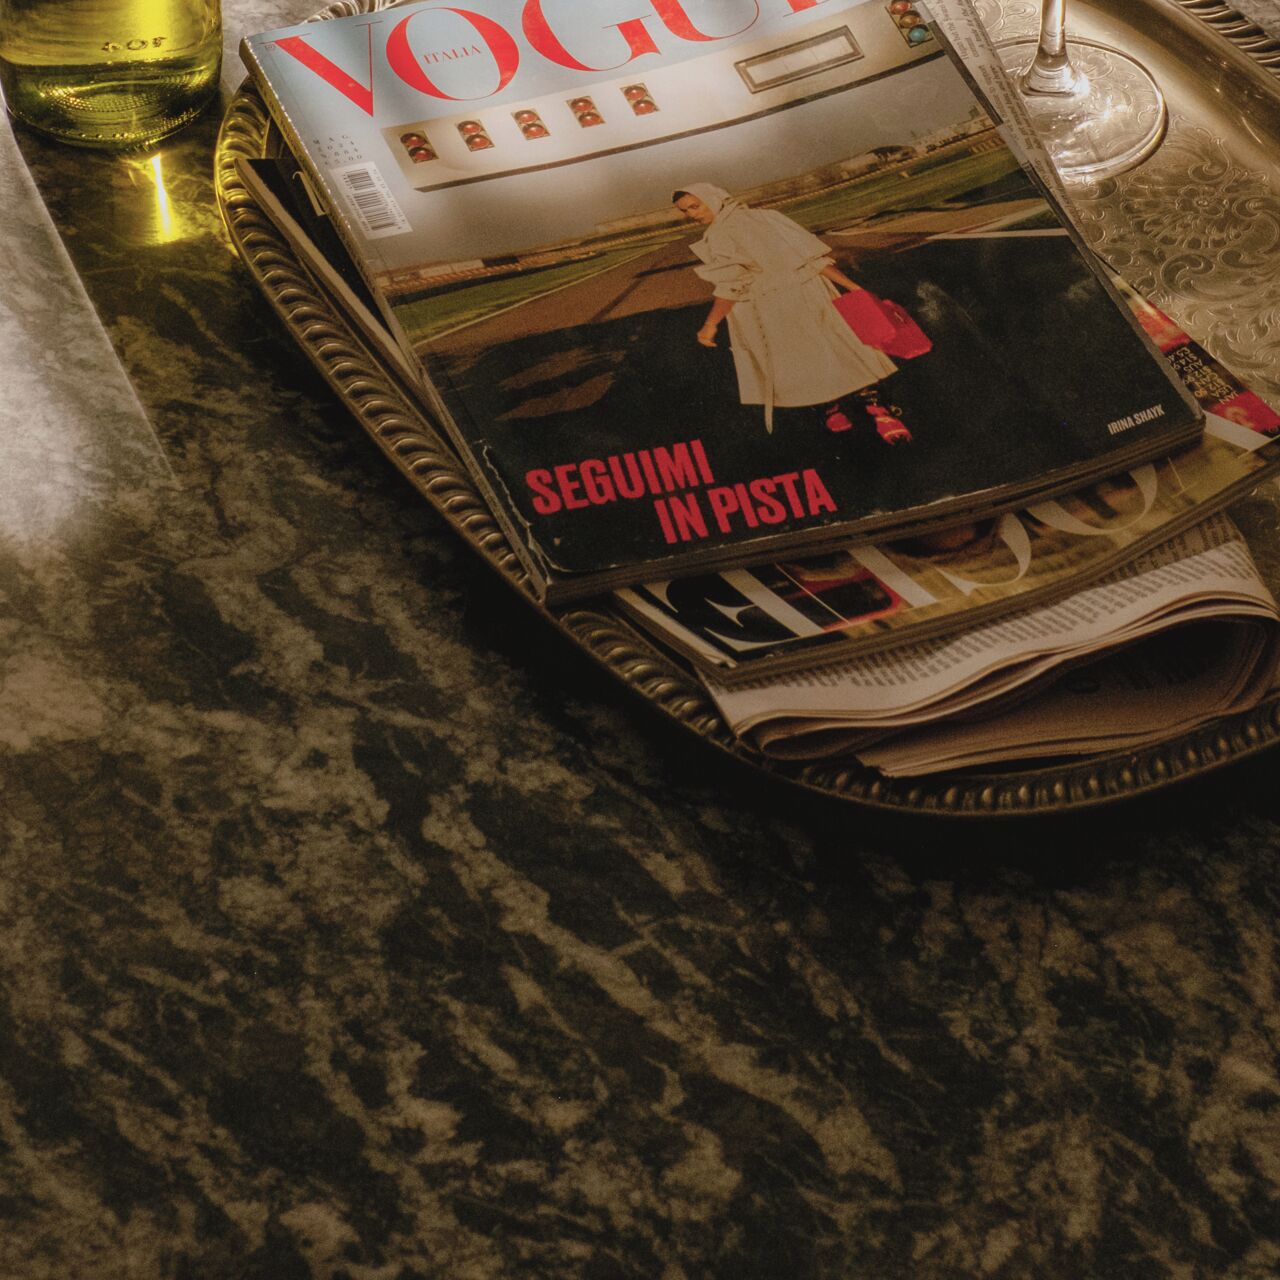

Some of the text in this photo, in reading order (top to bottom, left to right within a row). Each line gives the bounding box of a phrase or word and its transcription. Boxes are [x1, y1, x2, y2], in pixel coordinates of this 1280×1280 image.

[423, 42, 482, 67] ITALIA
[1171, 353, 1195, 370] $14.9
[1184, 360, 1201, 373] AUS
[1107, 403, 1165, 436] IRINA SHAYK
[524, 438, 715, 516] SEGUIMI
[653, 467, 838, 545] IN PISTA
